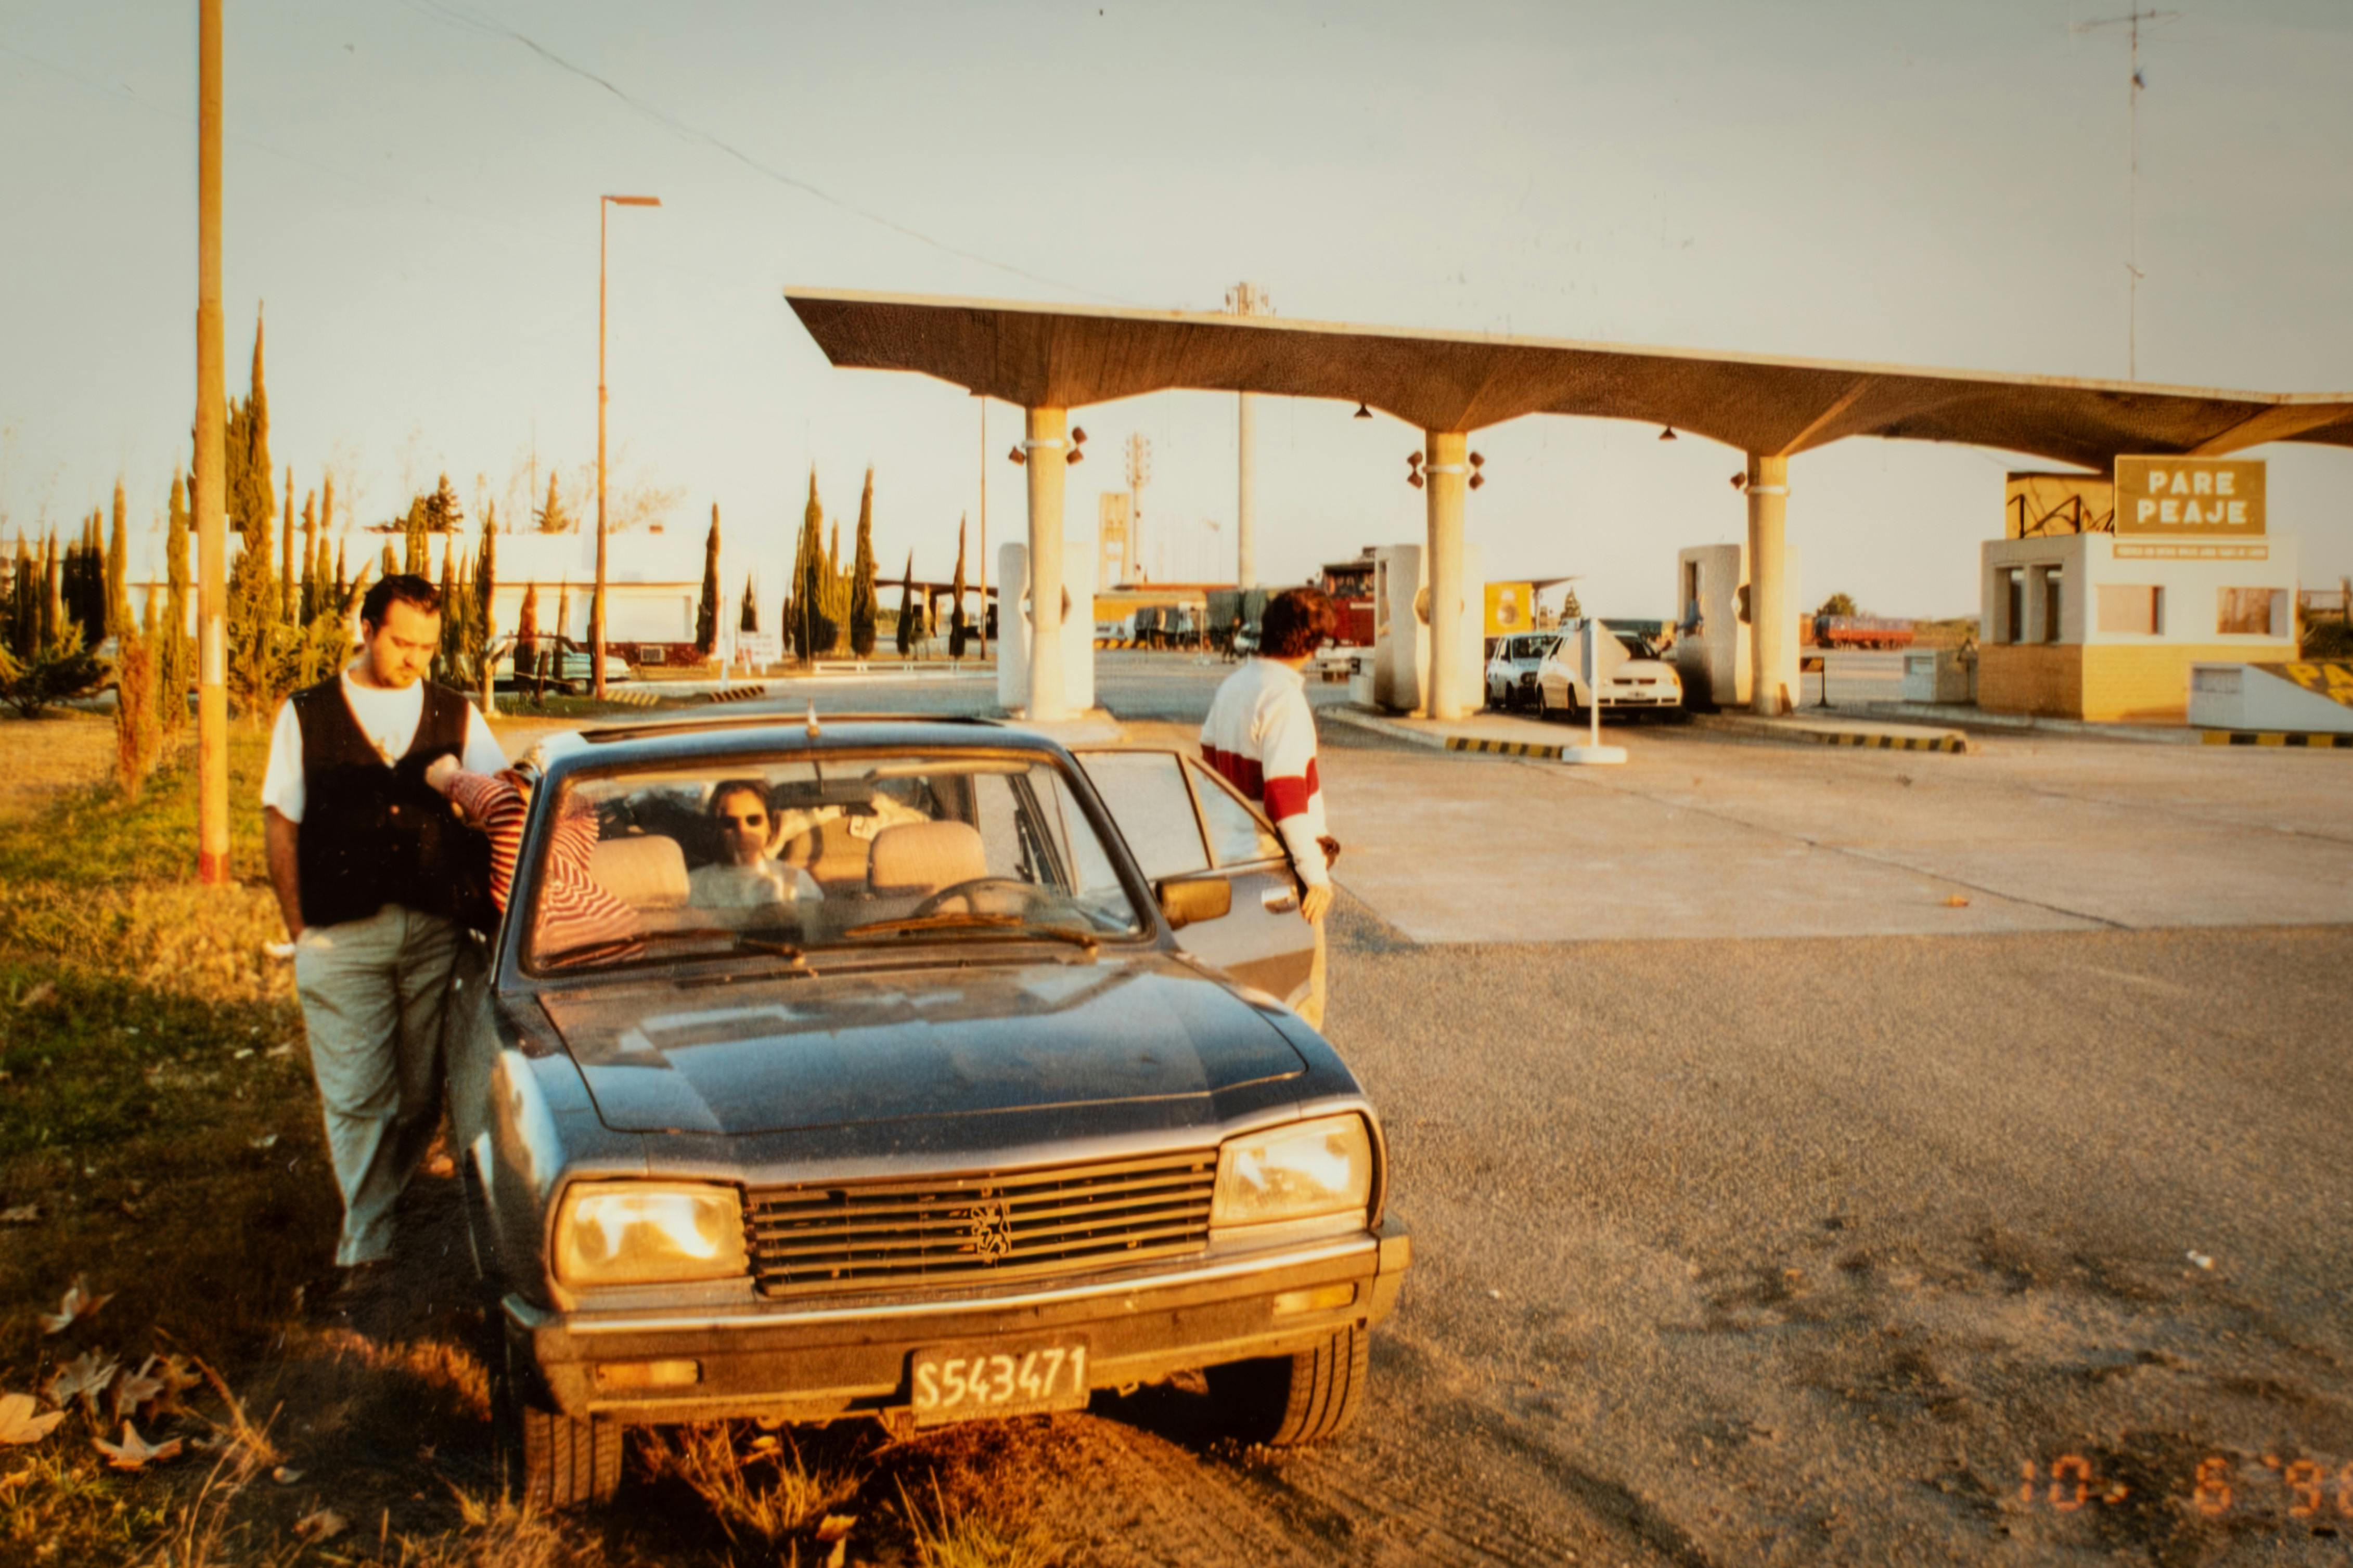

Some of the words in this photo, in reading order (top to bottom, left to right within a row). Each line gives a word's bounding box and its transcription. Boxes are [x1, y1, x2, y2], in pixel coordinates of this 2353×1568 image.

[2149, 471, 2235, 495] PARE
[2137, 499, 2247, 524] PEAJE
[916, 1345, 1086, 1410] S543471
